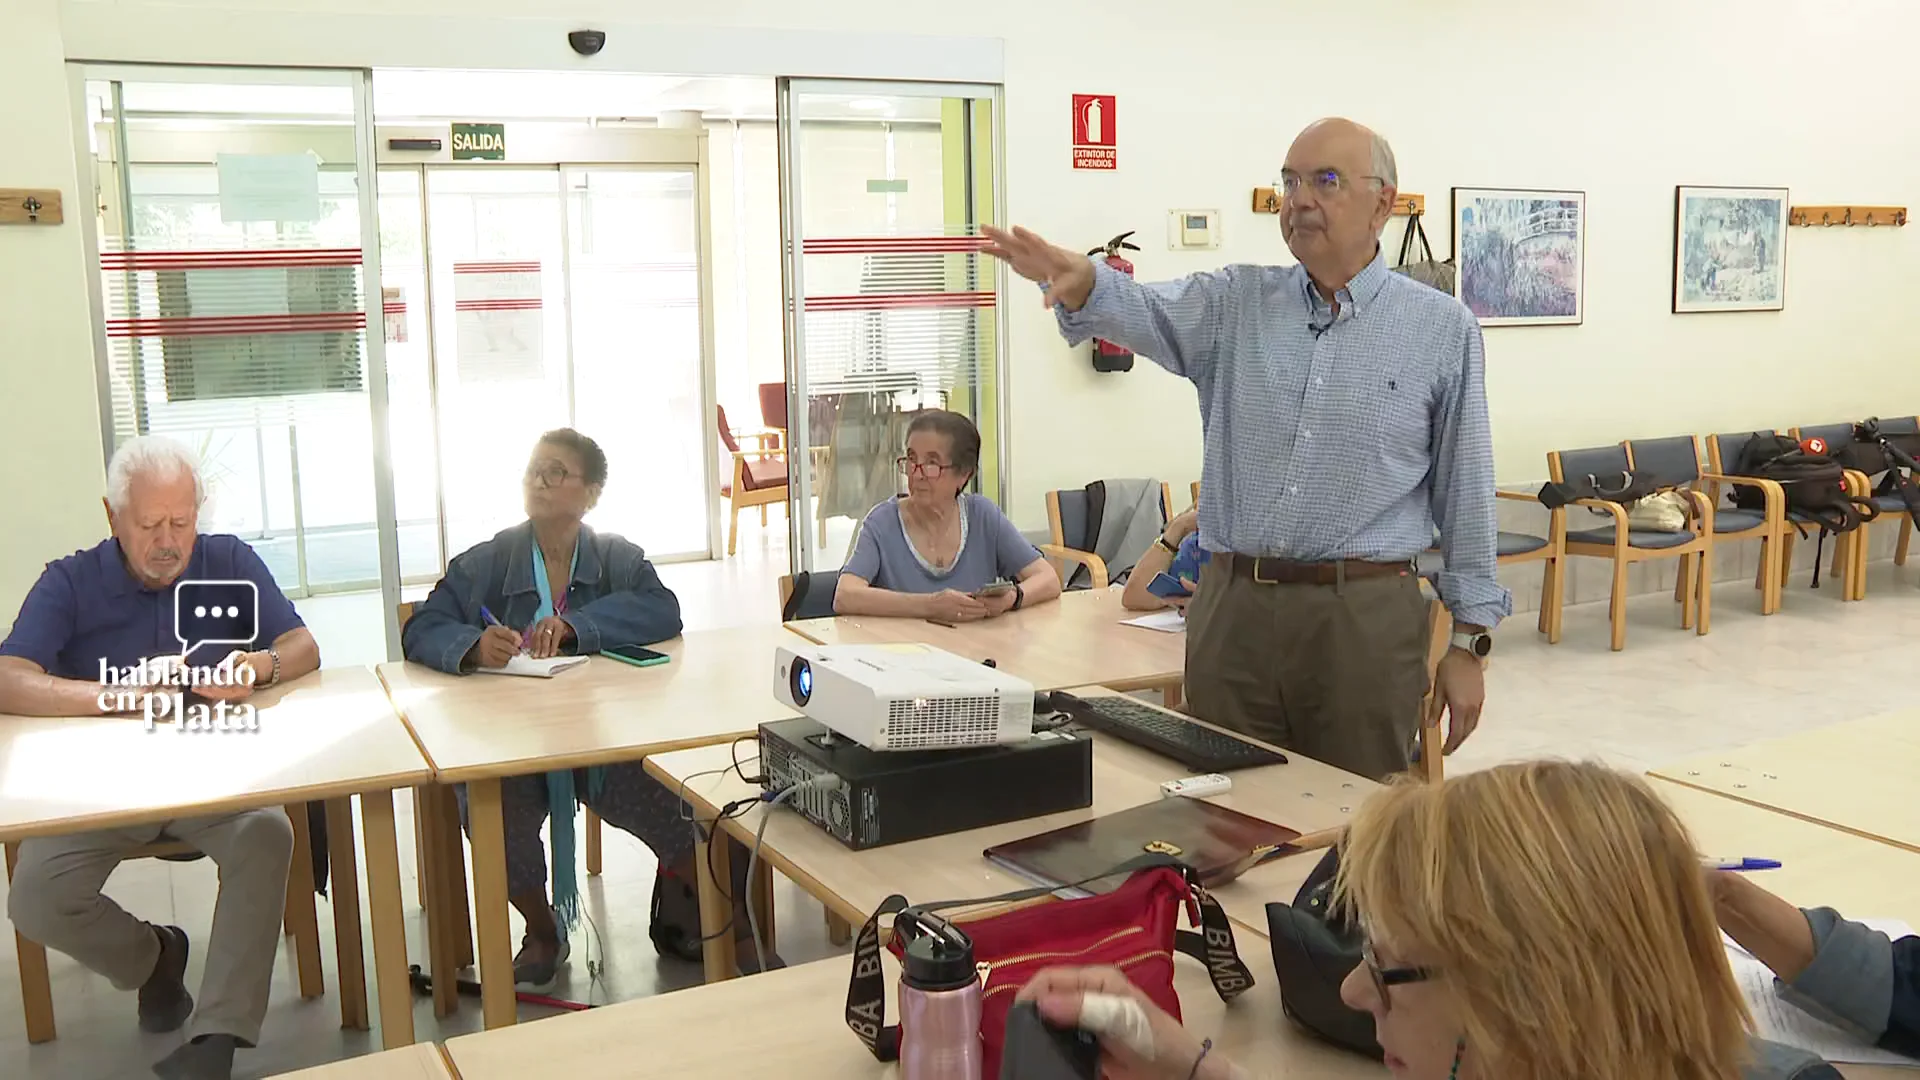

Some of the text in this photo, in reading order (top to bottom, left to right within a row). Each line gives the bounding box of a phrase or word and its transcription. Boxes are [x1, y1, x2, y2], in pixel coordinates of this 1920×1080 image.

[453, 132, 504, 150] SALIDA
[1074, 149, 1116, 159] EXTINTOR DE
[1077, 158, 1113, 168] INCENDIOS
